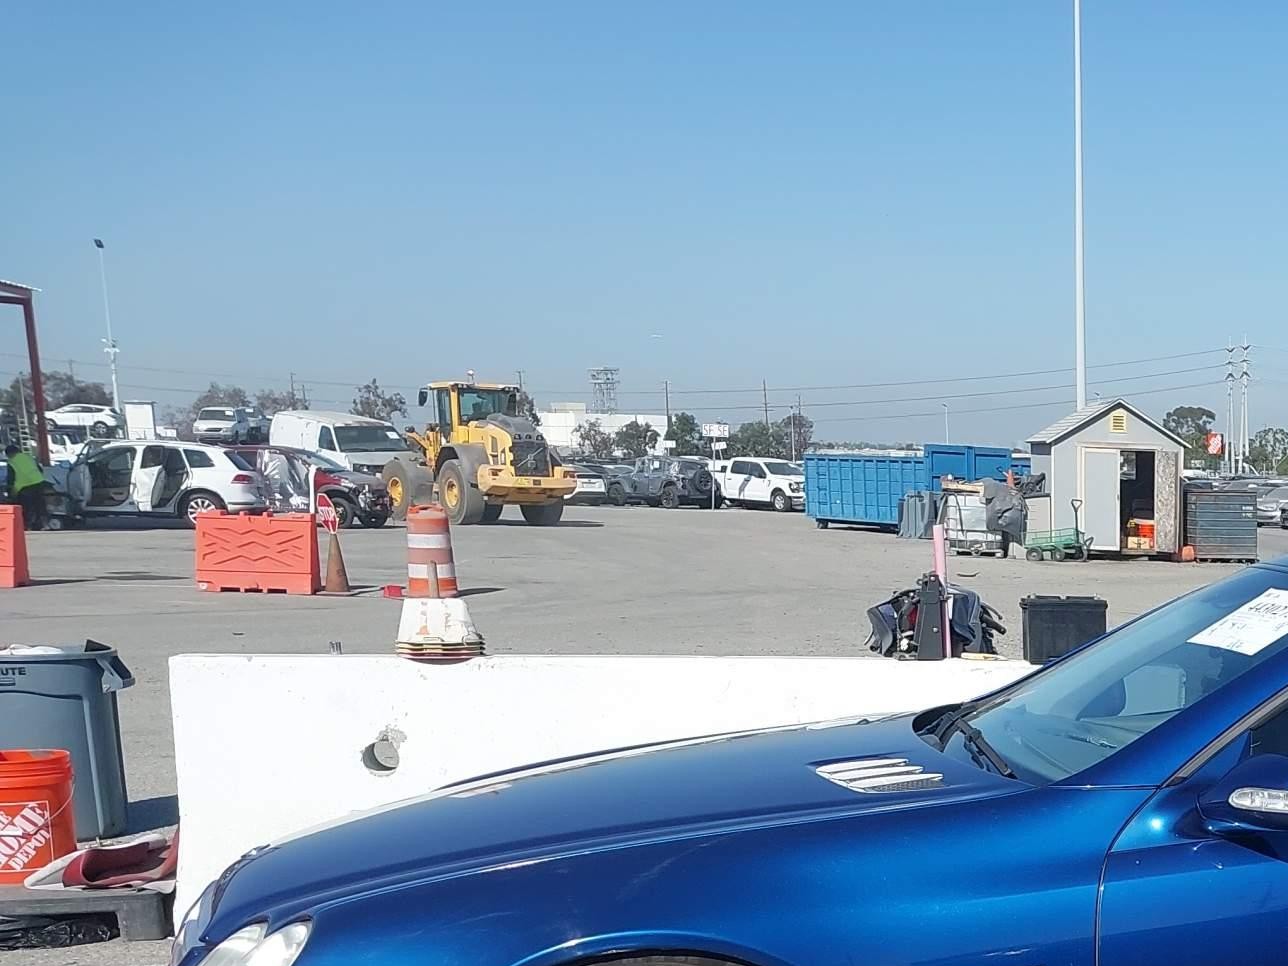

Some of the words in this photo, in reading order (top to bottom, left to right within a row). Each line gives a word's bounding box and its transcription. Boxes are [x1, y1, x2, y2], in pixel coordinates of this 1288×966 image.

[318, 506, 336, 521] STOP
[0, 803, 48, 870] OME
[7, 829, 51, 871] DEPOT
